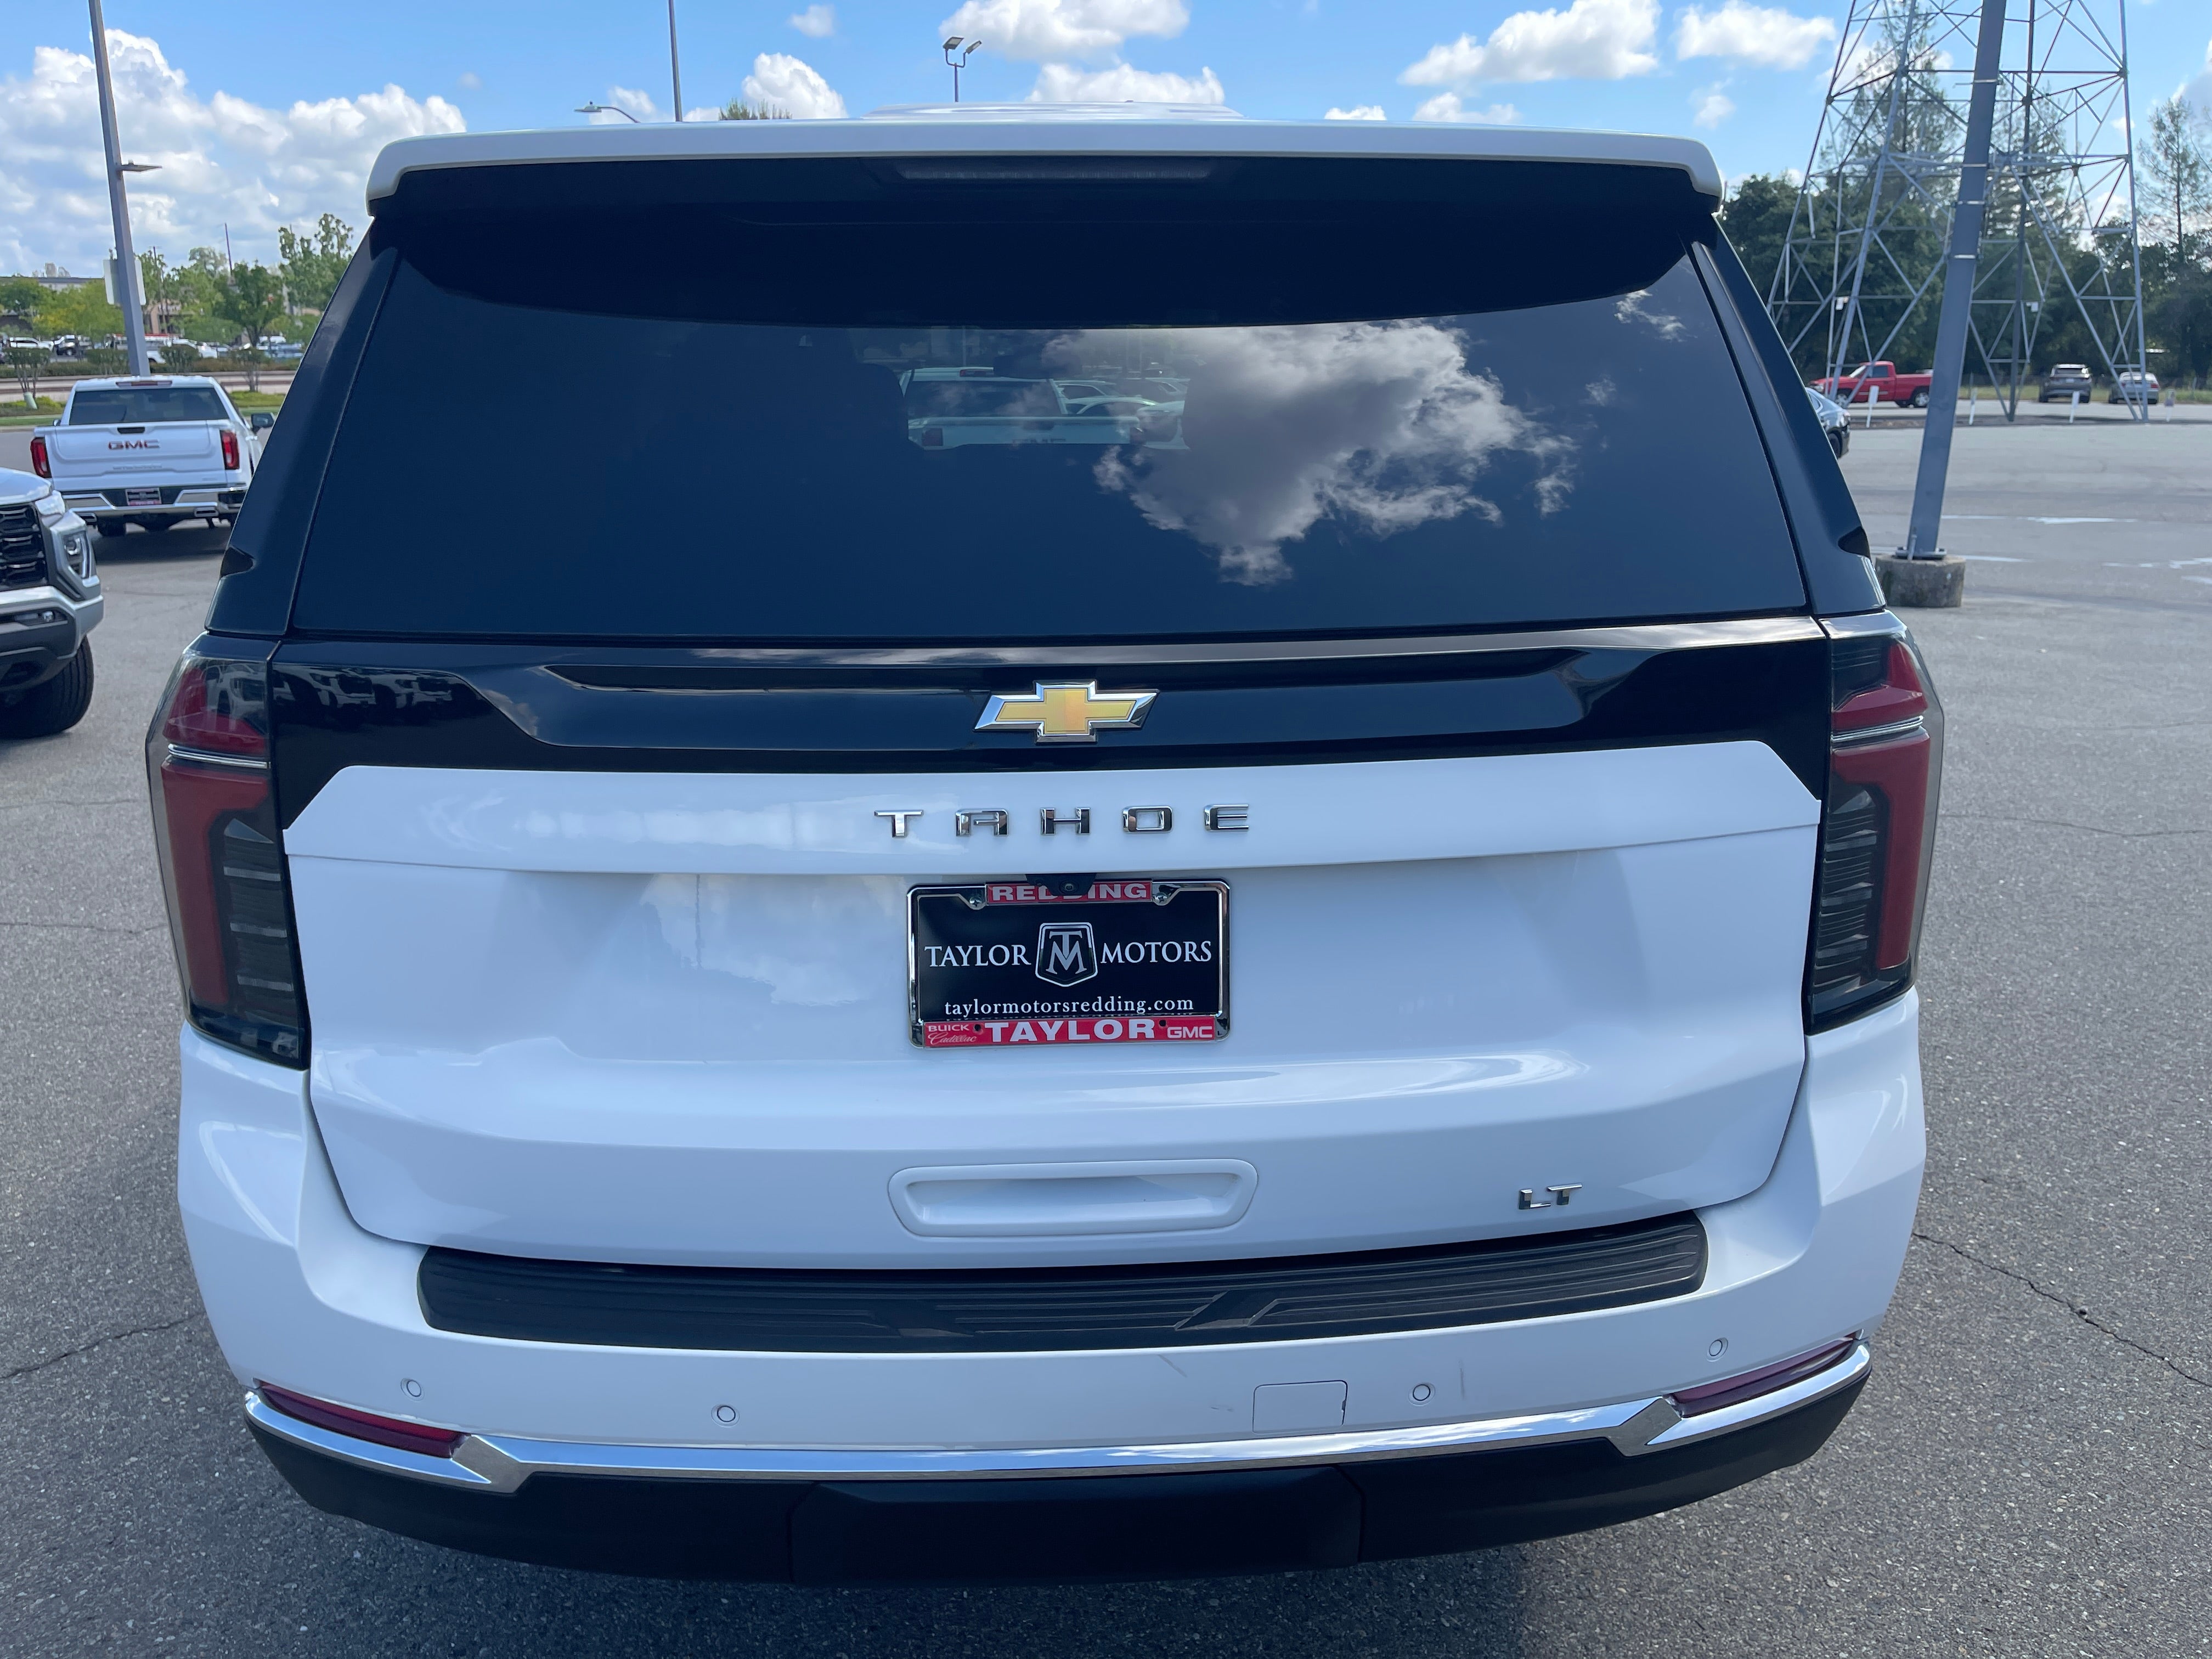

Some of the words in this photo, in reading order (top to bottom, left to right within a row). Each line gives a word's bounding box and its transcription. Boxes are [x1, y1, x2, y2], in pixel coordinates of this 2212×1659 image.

[109, 439, 160, 449] GMC
[874, 804, 1249, 837] TAHOE
[992, 883, 1147, 901] REDING
[924, 945, 1031, 967] TAYLOR
[1101, 941, 1211, 963] MOTORS
[945, 996, 1193, 1018] taylormotorsredding.com
[928, 1032, 977, 1045] Cadillac
[985, 1019, 1155, 1042] TAYLOR
[1167, 1026, 1212, 1038] GMC
[1519, 1183, 1582, 1210] LT
